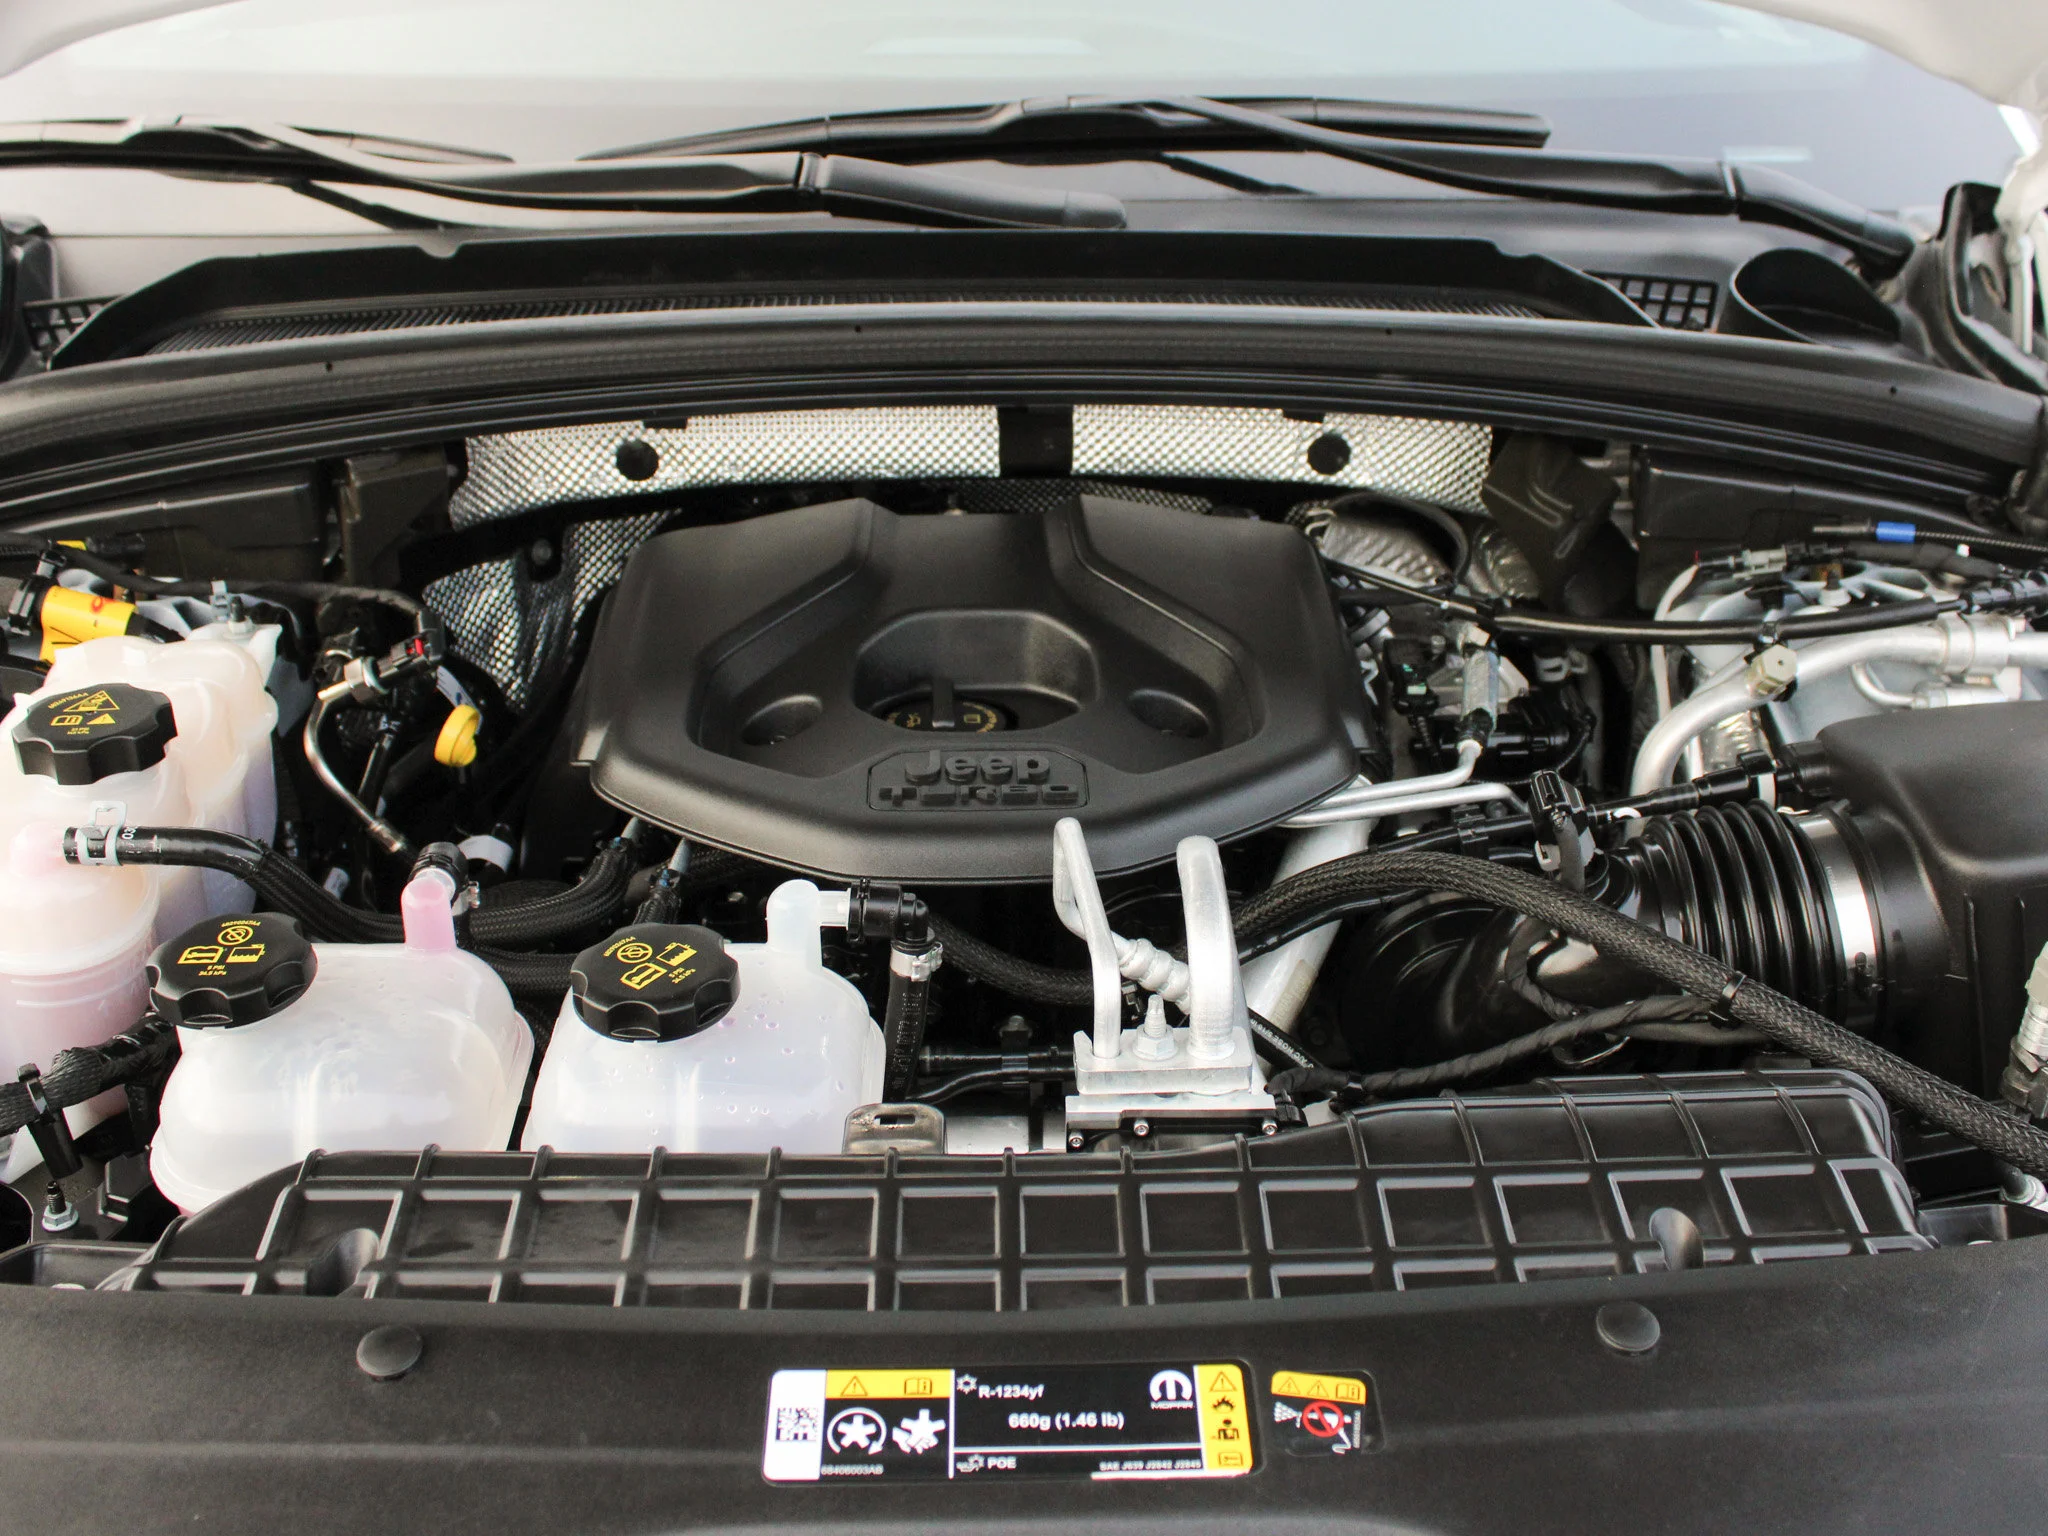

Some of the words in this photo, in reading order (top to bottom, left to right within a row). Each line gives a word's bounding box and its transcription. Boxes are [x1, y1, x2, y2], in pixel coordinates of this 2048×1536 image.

[905, 750, 1050, 784] Jeep
[878, 784, 1079, 807] TURBO
[673, 967, 685, 975] PSI
[1274, 1035, 1294, 1053] HOSE
[978, 1384, 1045, 1400] R-1234yf
[1008, 1412, 1051, 1431] 660g
[1055, 1412, 1098, 1431] (1.46
[1101, 1412, 1125, 1430] lb)
[987, 1456, 1017, 1469] POE
